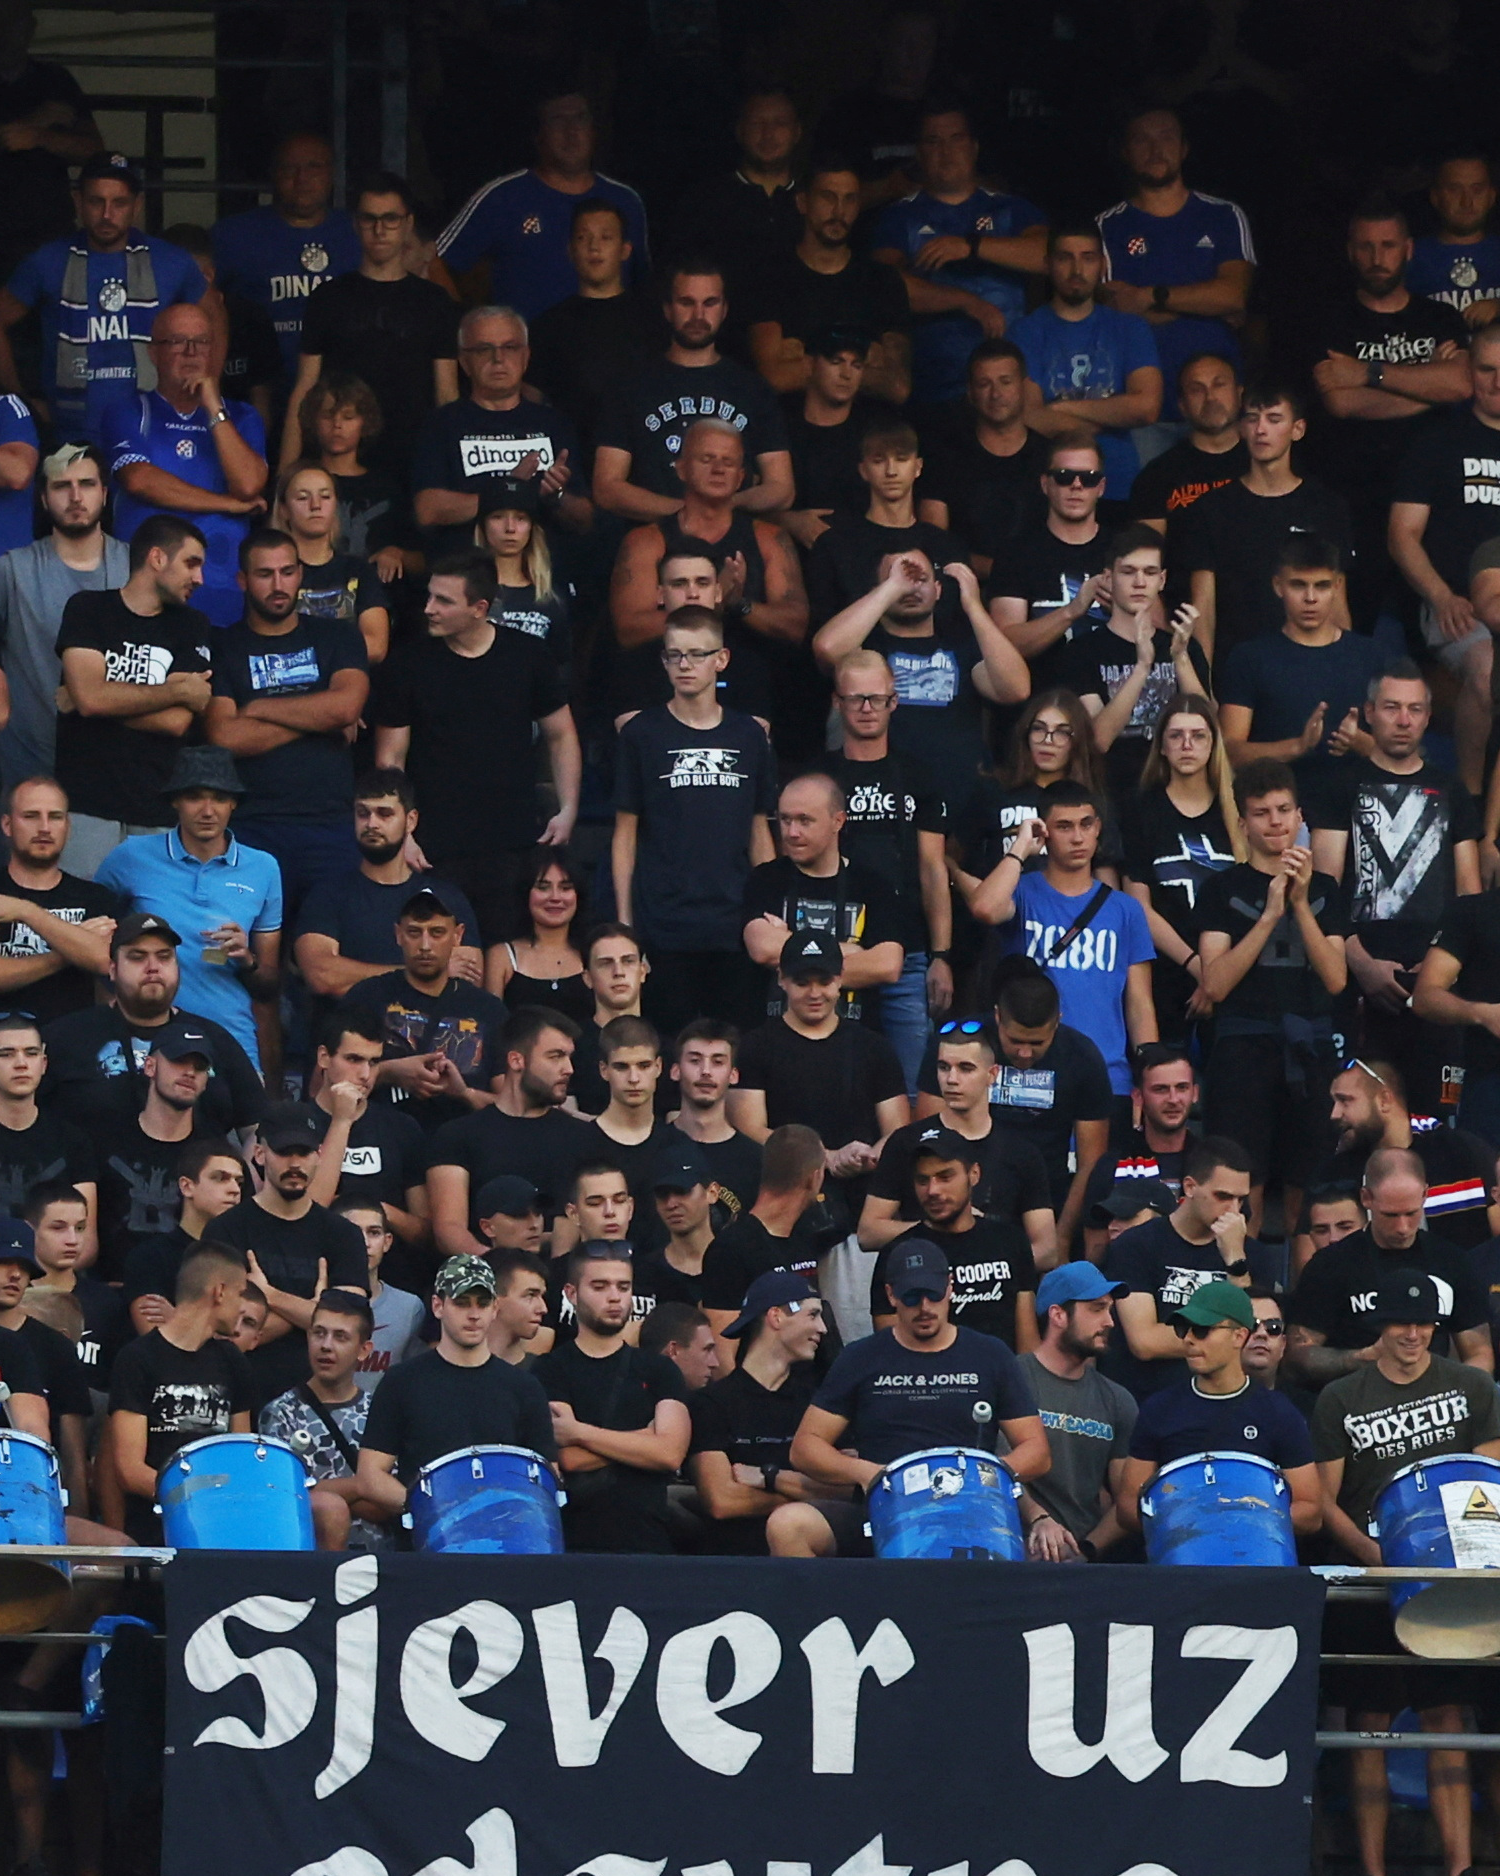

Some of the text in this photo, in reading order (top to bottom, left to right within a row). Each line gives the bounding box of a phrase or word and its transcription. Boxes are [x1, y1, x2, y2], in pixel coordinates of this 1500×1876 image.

[645, 396, 748, 432] SERBUS
[122, 641, 150, 659] THE
[670, 774, 740, 788] BAD BLUE BOYS
[955, 1261, 1011, 1285] COOPER
[1349, 1290, 1378, 1313] NC
[873, 1373, 980, 1387] JACK & JONES
[1355, 1395, 1470, 1451] BOXEUR
[1366, 1405, 1394, 1418] FIGHT
[1373, 1427, 1457, 1460] DES RUES
[184, 1554, 1298, 1800] sjever uz
